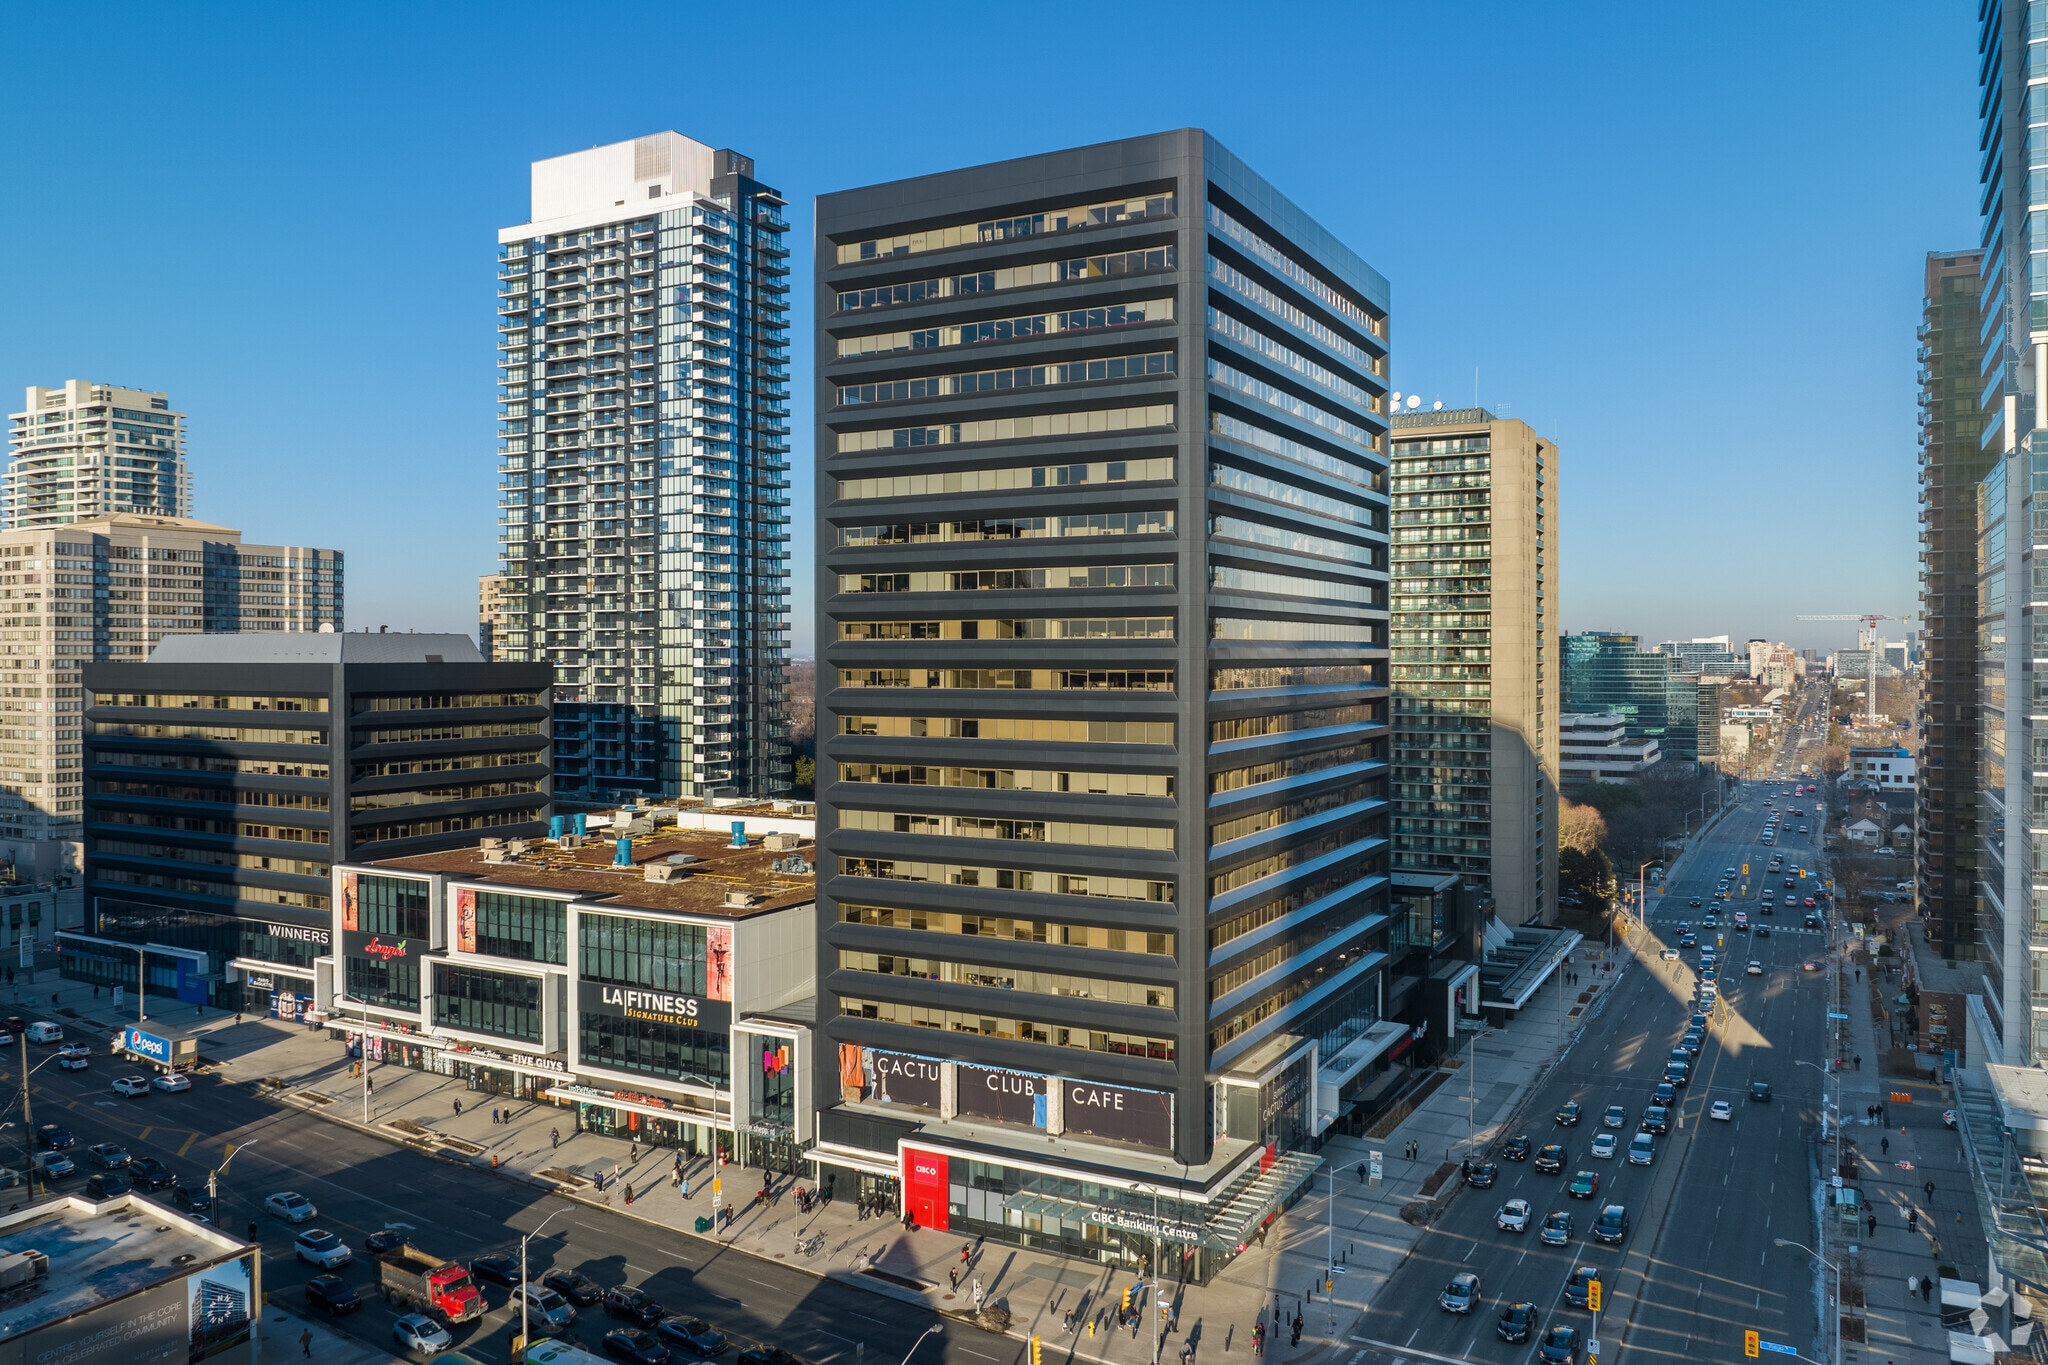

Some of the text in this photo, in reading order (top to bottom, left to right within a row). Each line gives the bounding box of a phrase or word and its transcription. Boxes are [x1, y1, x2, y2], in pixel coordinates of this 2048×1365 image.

[268, 924, 329, 944] WINNERS
[602, 987, 698, 1017] LA FITNESS
[627, 1008, 699, 1027] SIGNATURE CLUB
[141, 1038, 163, 1055] pepsi
[512, 1053, 563, 1072] FIVE GUYS
[877, 1057, 939, 1082] CACTU
[986, 1074, 1035, 1097] CLUB
[1072, 1087, 1124, 1112] CAFE
[1262, 1096, 1284, 1121] CACTUS
[1284, 1087, 1297, 1104] CLUB
[915, 1165, 930, 1174] CIBC
[1091, 1211, 1198, 1241] CIBC Banking Centre
[38, 1301, 182, 1363] CENTRE YOURSELF IN THE CORE
[64, 1336, 122, 1365] CELEBRATED
[123, 1314, 178, 1342] COMMUNITY
